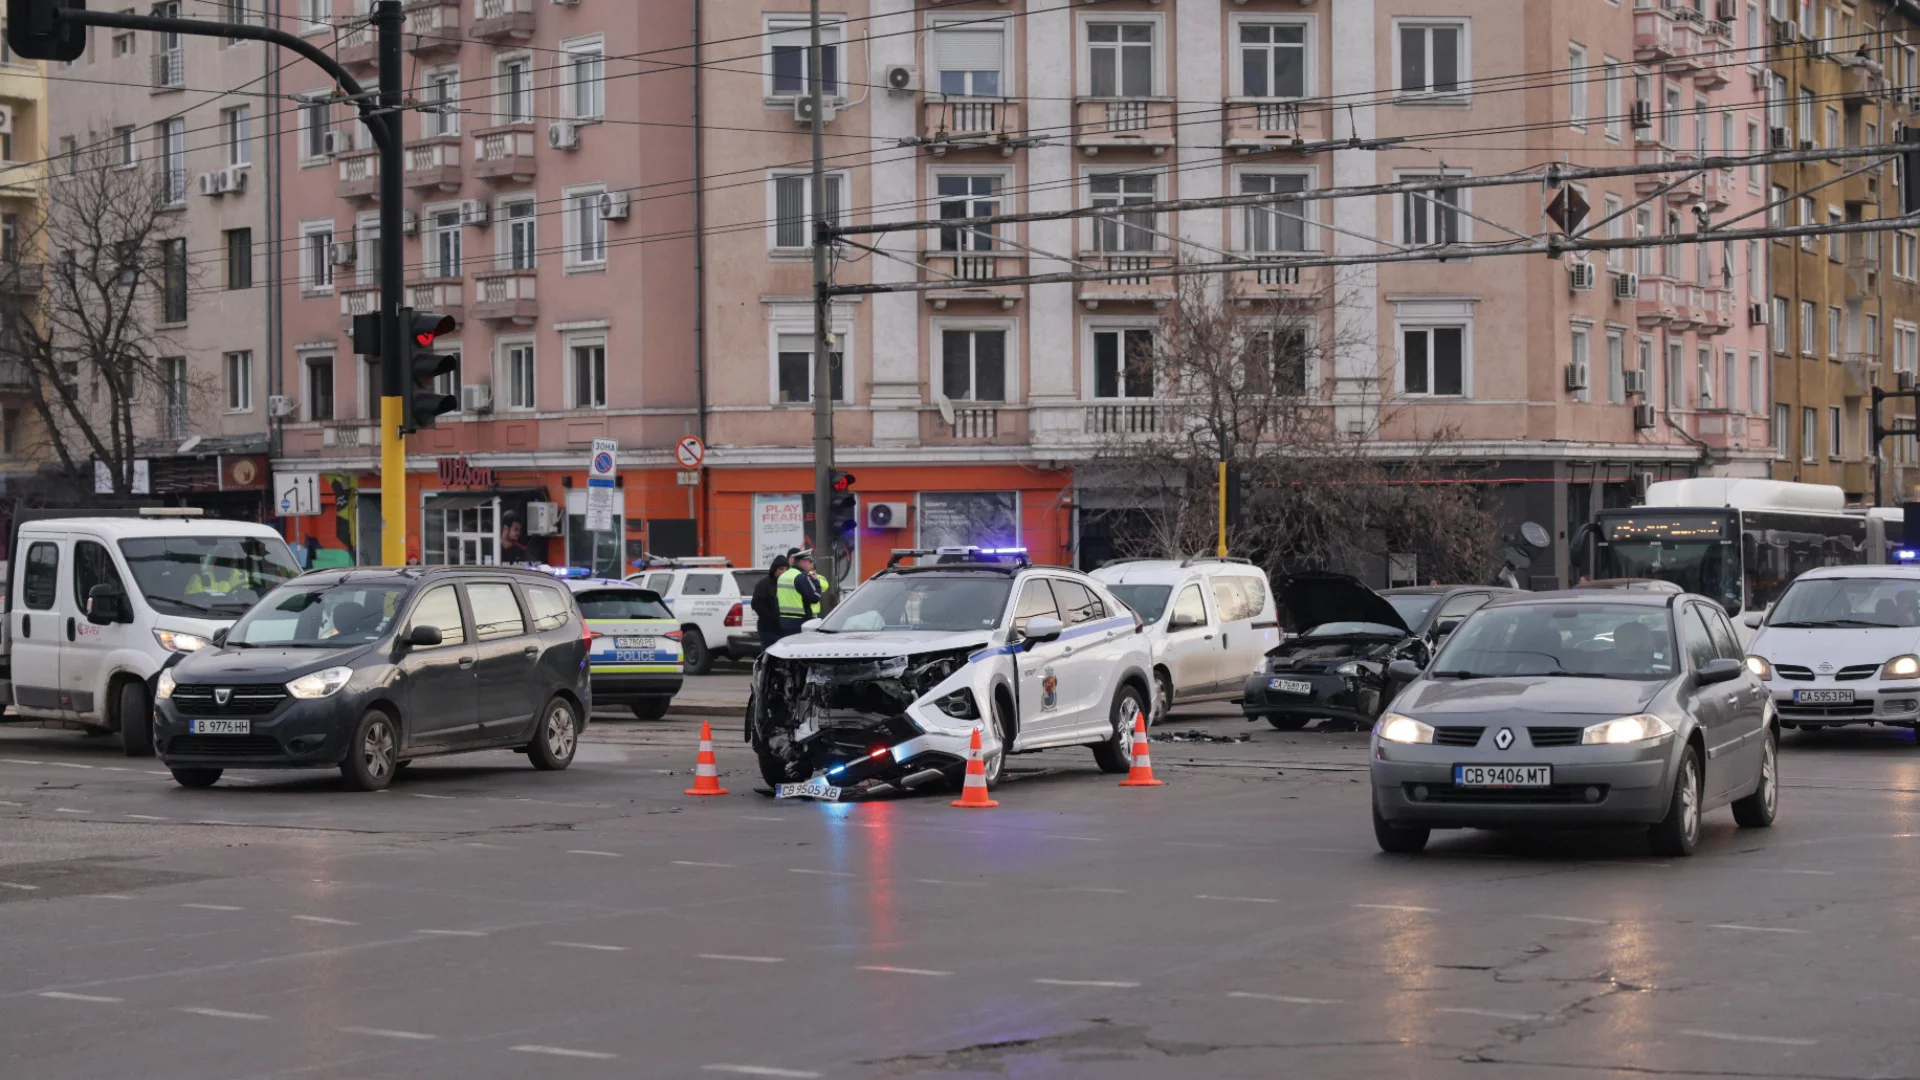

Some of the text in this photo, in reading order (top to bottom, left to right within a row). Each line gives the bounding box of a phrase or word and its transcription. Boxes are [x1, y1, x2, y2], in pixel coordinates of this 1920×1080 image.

[595, 442, 615, 451] ЗОНА
[436, 456, 493, 486] Wilson
[766, 504, 800, 513] PLAY
[762, 512, 817, 522] FEARLE
[616, 651, 655, 661] POLICE
[1800, 691, 1852, 701] CA 5953 PH
[209, 721, 234, 732] 9776
[1465, 768, 1548, 783] CB 9406 MT
[796, 784, 821, 796] 9505
